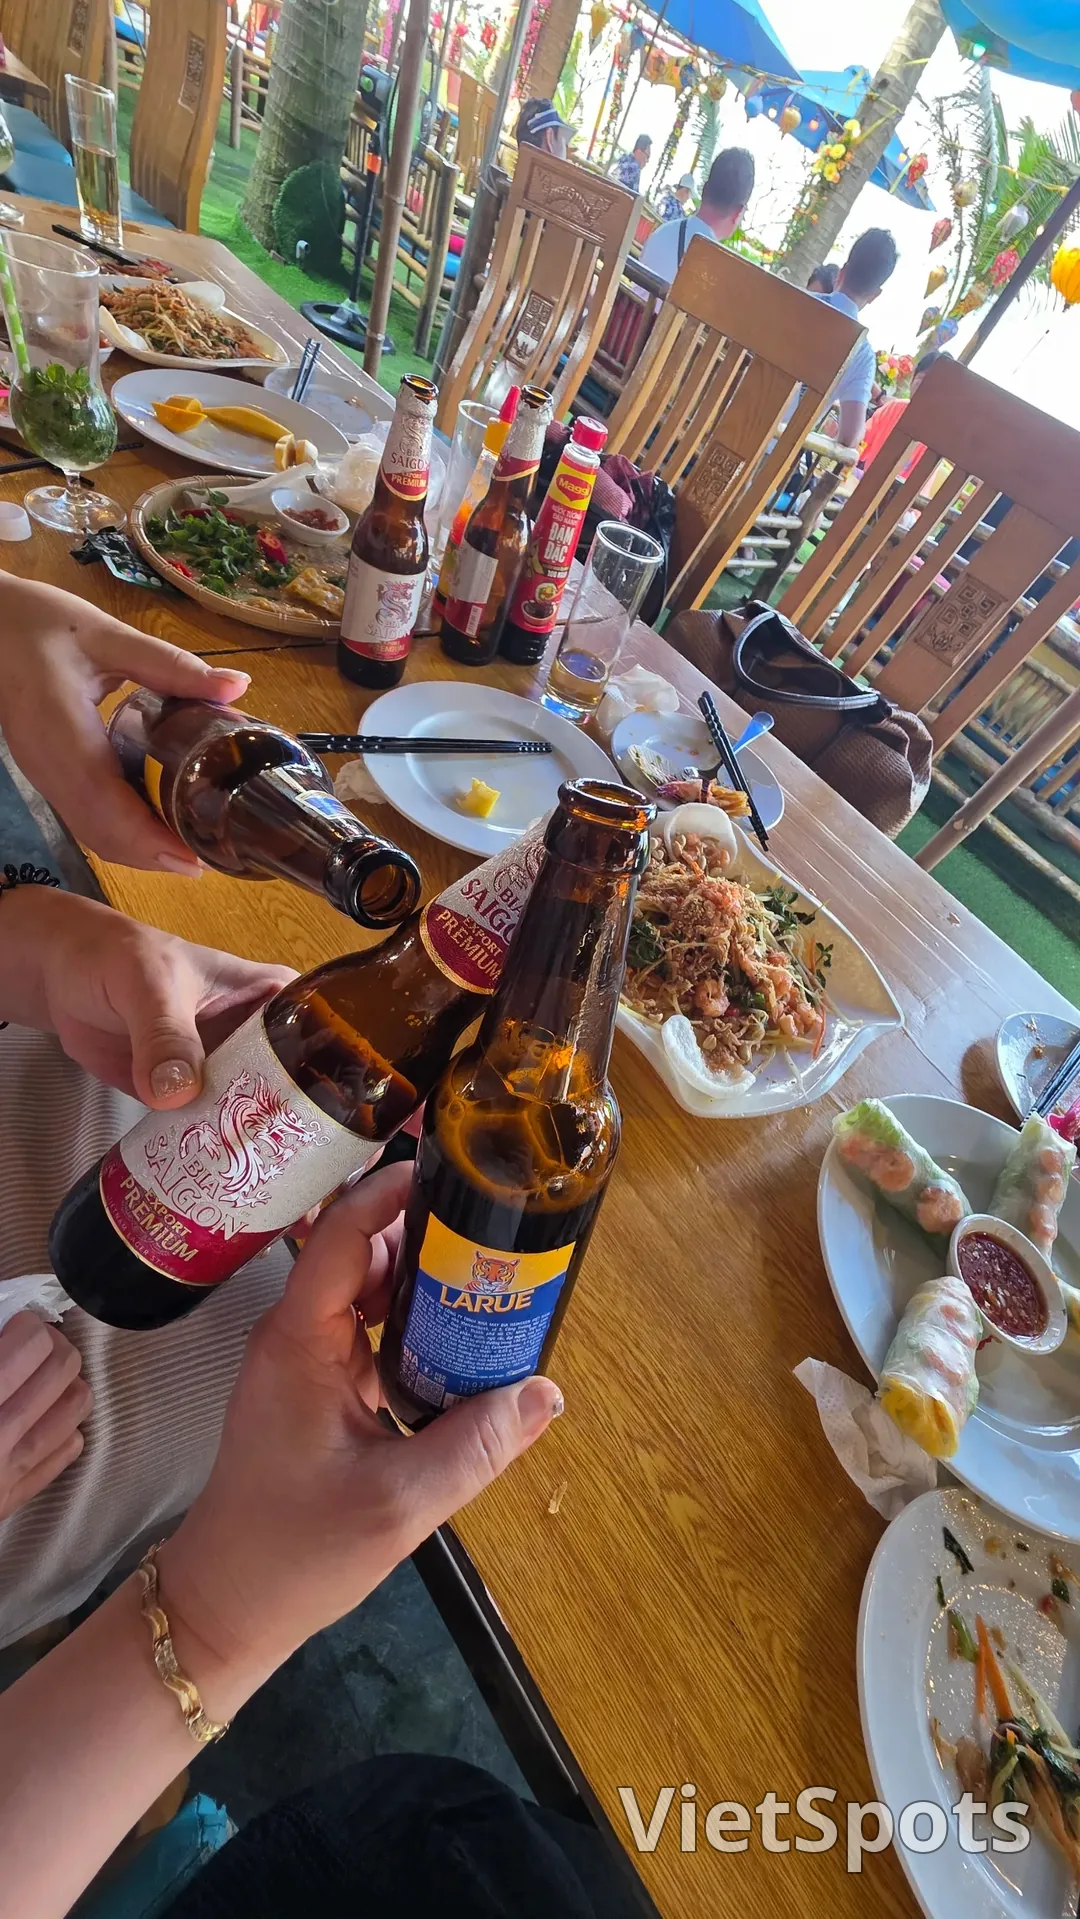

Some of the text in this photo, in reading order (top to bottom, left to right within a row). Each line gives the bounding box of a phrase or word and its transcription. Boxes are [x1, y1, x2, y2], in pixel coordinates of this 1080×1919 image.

[436, 909, 502, 981] PREMIUM
[463, 914, 503, 957] EXPORT
[144, 1133, 248, 1241] SAIGON
[183, 1154, 221, 1199] BIA
[120, 1175, 199, 1262] PREMIUM
[144, 1188, 192, 1237] EXPORT
[440, 1285, 535, 1313] LARUE
[403, 1345, 418, 1367] BIA
